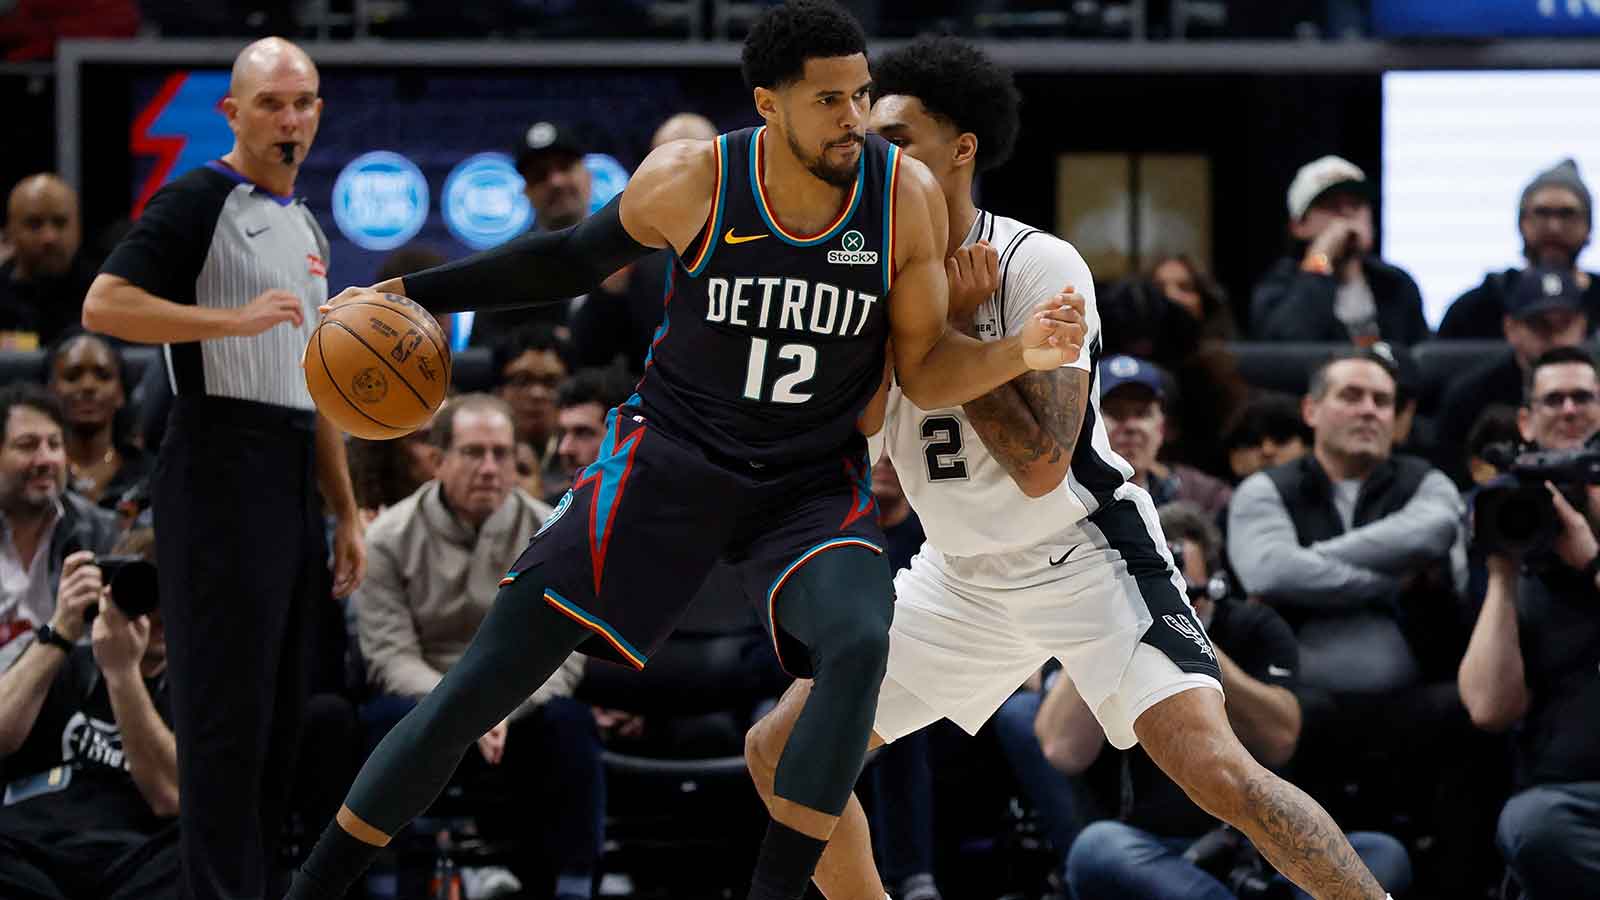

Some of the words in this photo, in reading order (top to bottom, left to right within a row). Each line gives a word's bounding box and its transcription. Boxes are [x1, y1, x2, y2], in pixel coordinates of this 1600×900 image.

[829, 252, 876, 263] StockX
[706, 278, 877, 336] DETROIT
[744, 335, 817, 403] 12
[920, 414, 970, 482] 2
